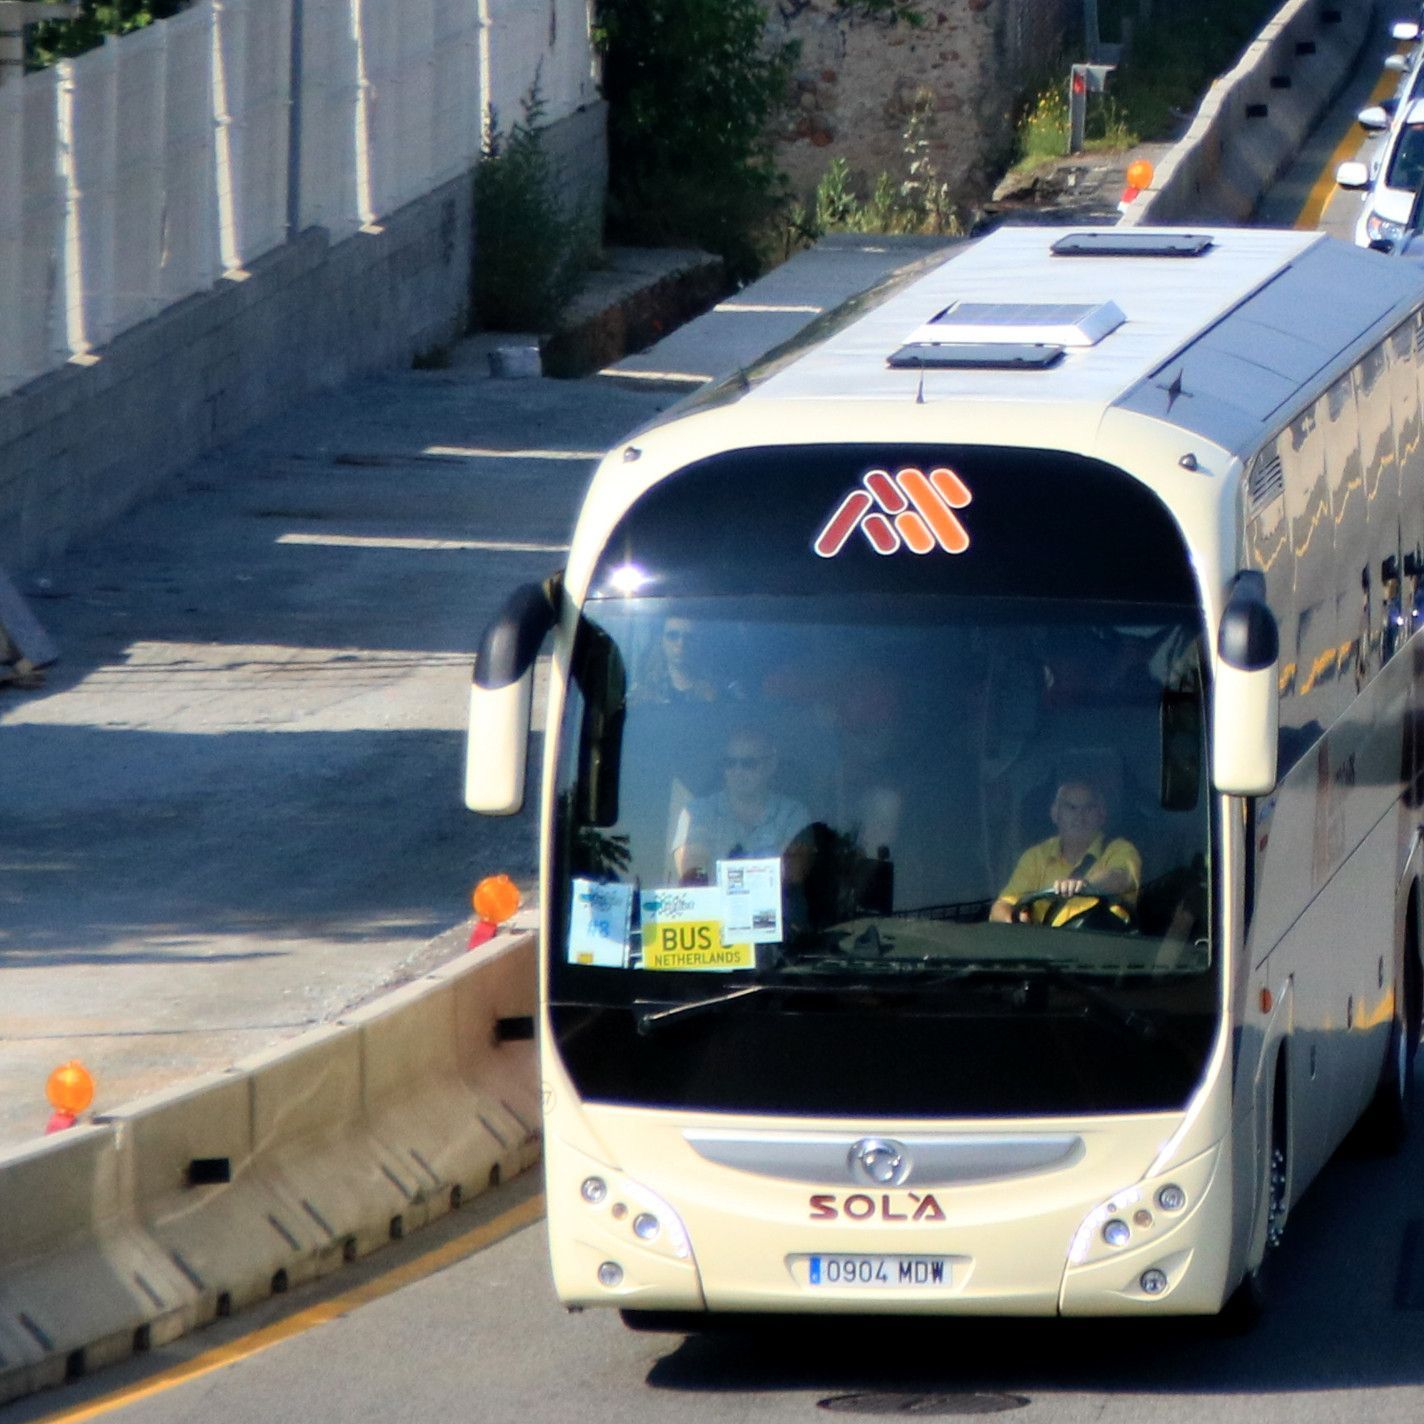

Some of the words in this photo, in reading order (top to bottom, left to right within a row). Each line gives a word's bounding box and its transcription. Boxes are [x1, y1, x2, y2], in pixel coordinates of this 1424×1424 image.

[662, 926, 712, 951] BUS
[654, 951, 741, 966] NETHERLANDS
[827, 1259, 889, 1283] 0904
[899, 1260, 945, 1284] MDW
